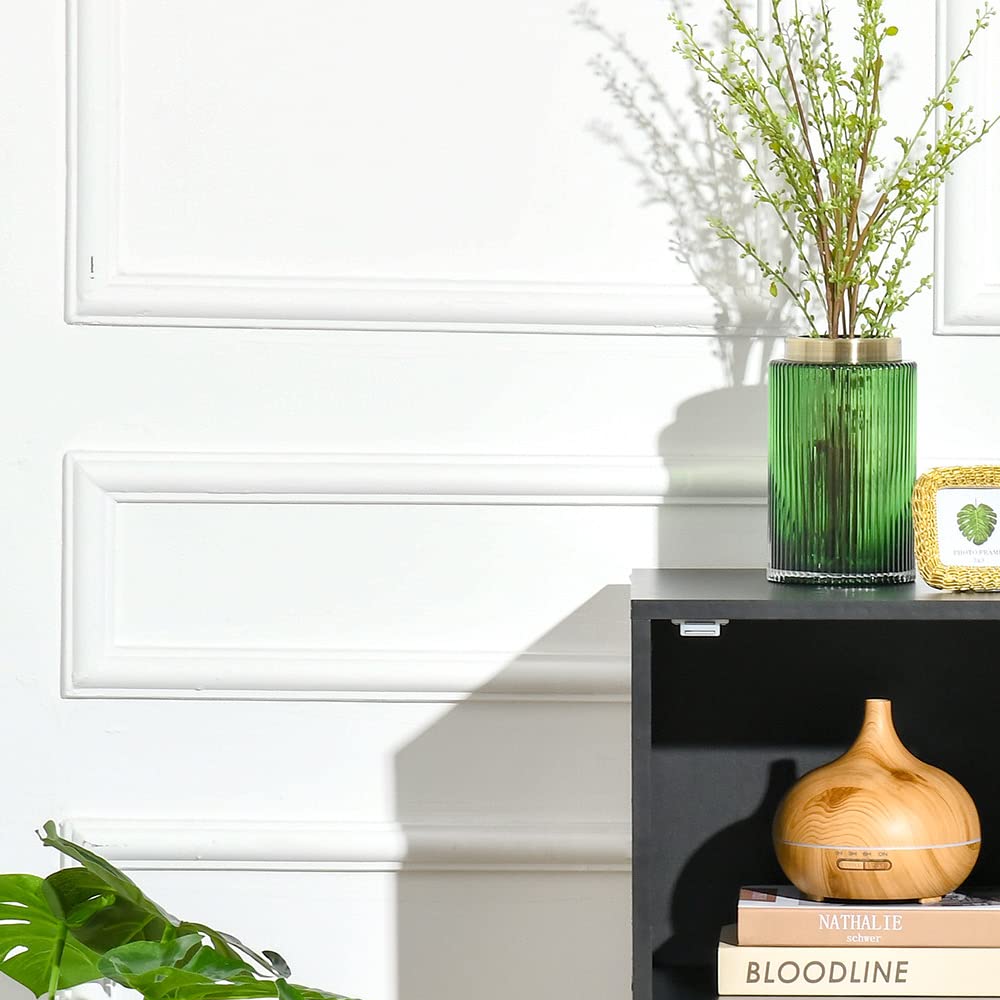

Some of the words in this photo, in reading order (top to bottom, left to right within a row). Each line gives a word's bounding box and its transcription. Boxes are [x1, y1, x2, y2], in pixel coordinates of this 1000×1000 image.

[818, 914, 903, 931] NATHALIE
[846, 934, 882, 943] schwer
[745, 960, 909, 984] BLOODLINE
